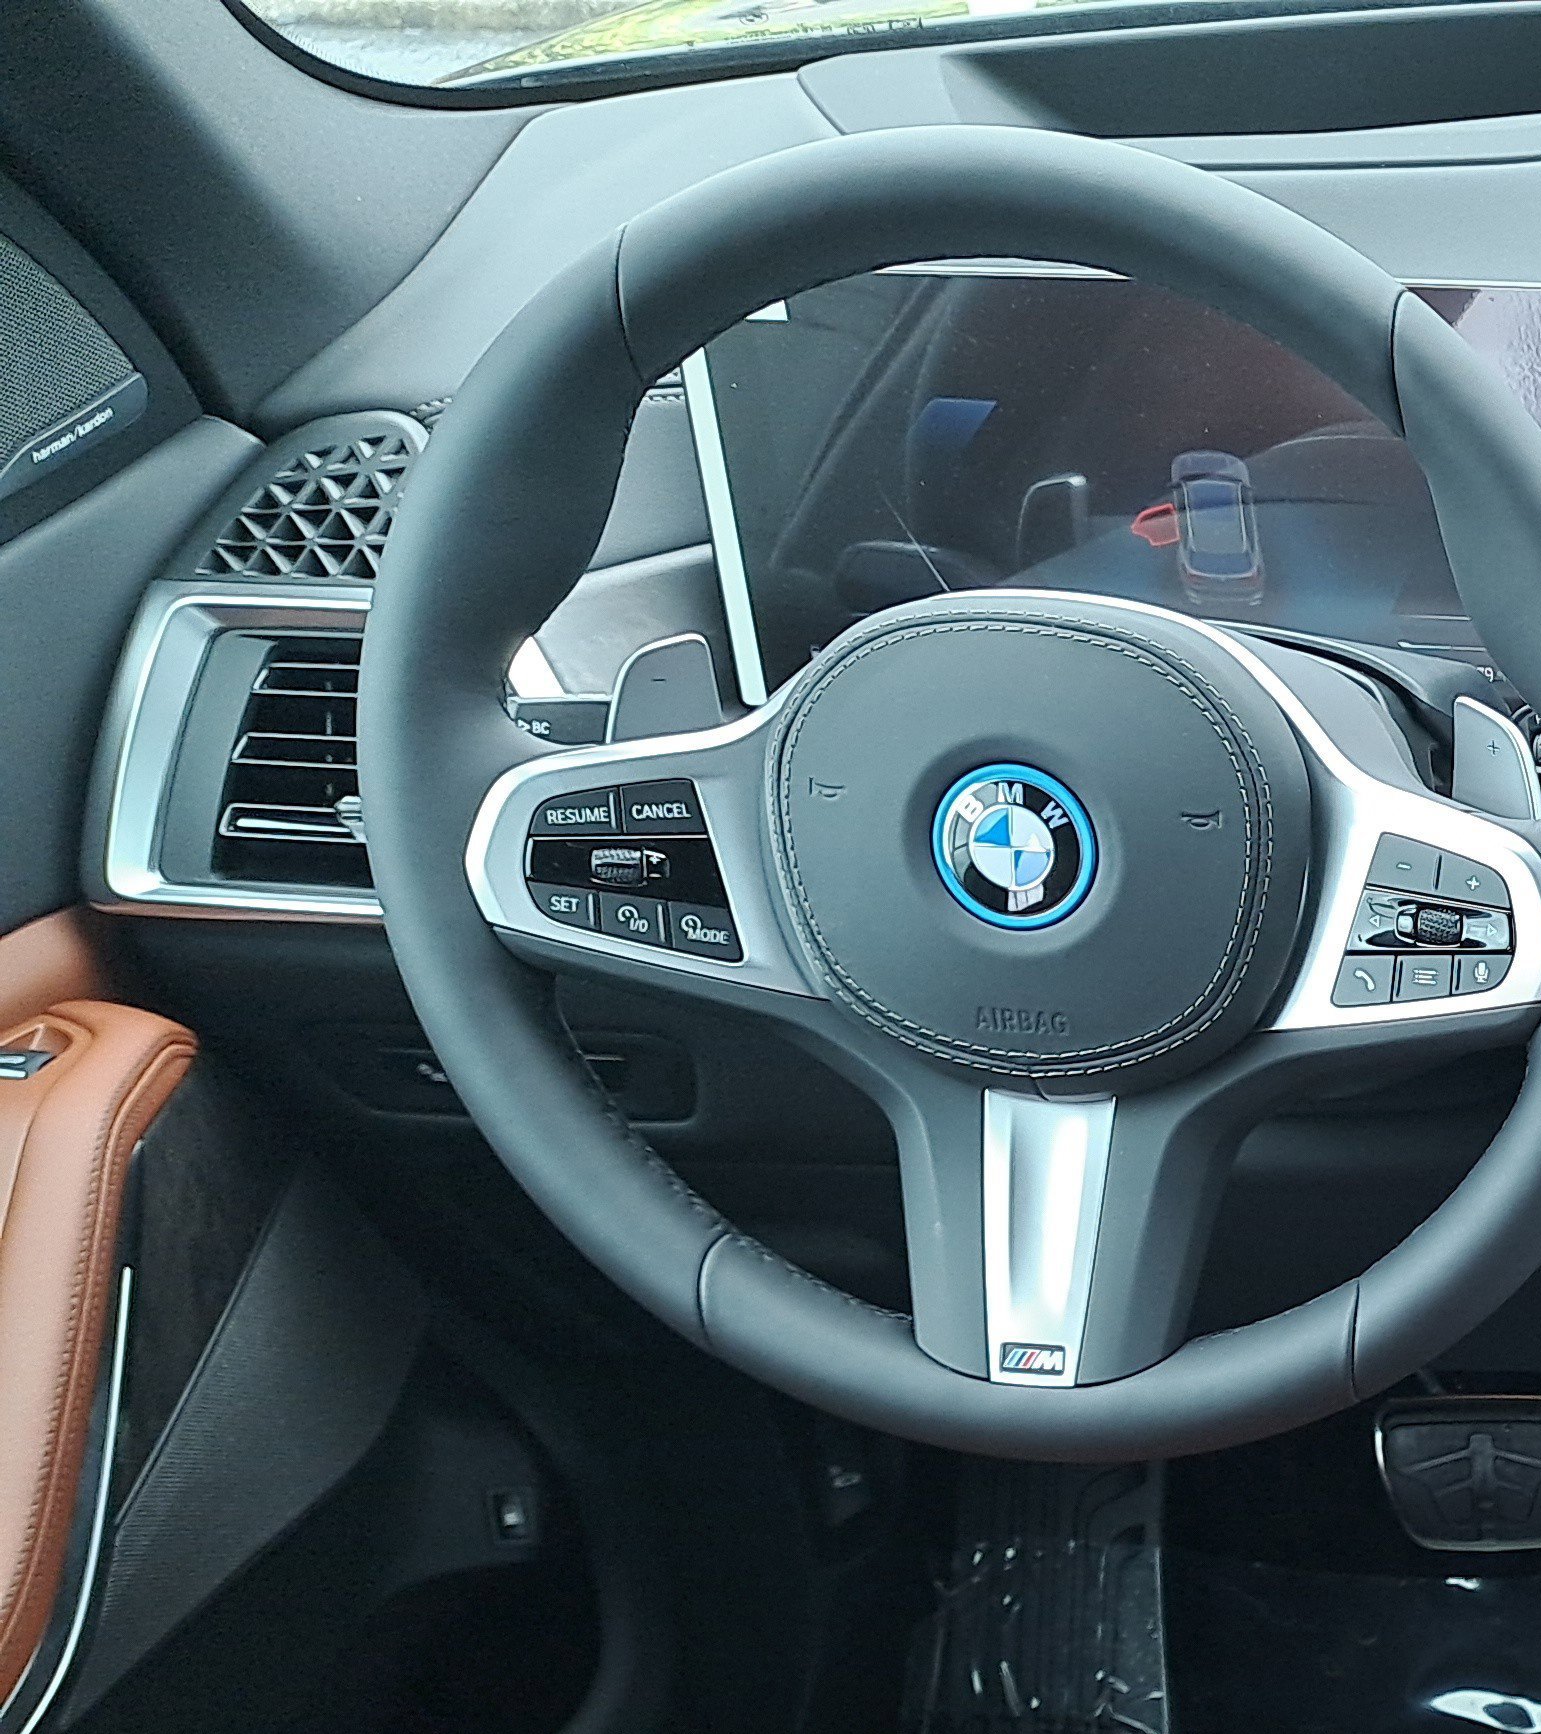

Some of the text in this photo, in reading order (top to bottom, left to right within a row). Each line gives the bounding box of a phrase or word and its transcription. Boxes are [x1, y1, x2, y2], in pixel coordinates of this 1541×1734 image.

[631, 802, 693, 820] CANCEL
[956, 782, 1070, 829] BMW
[546, 807, 610, 825] RESUME
[549, 895, 580, 912] SET
[687, 926, 731, 946] MODE
[976, 1006, 1068, 1035] AIRBAG
